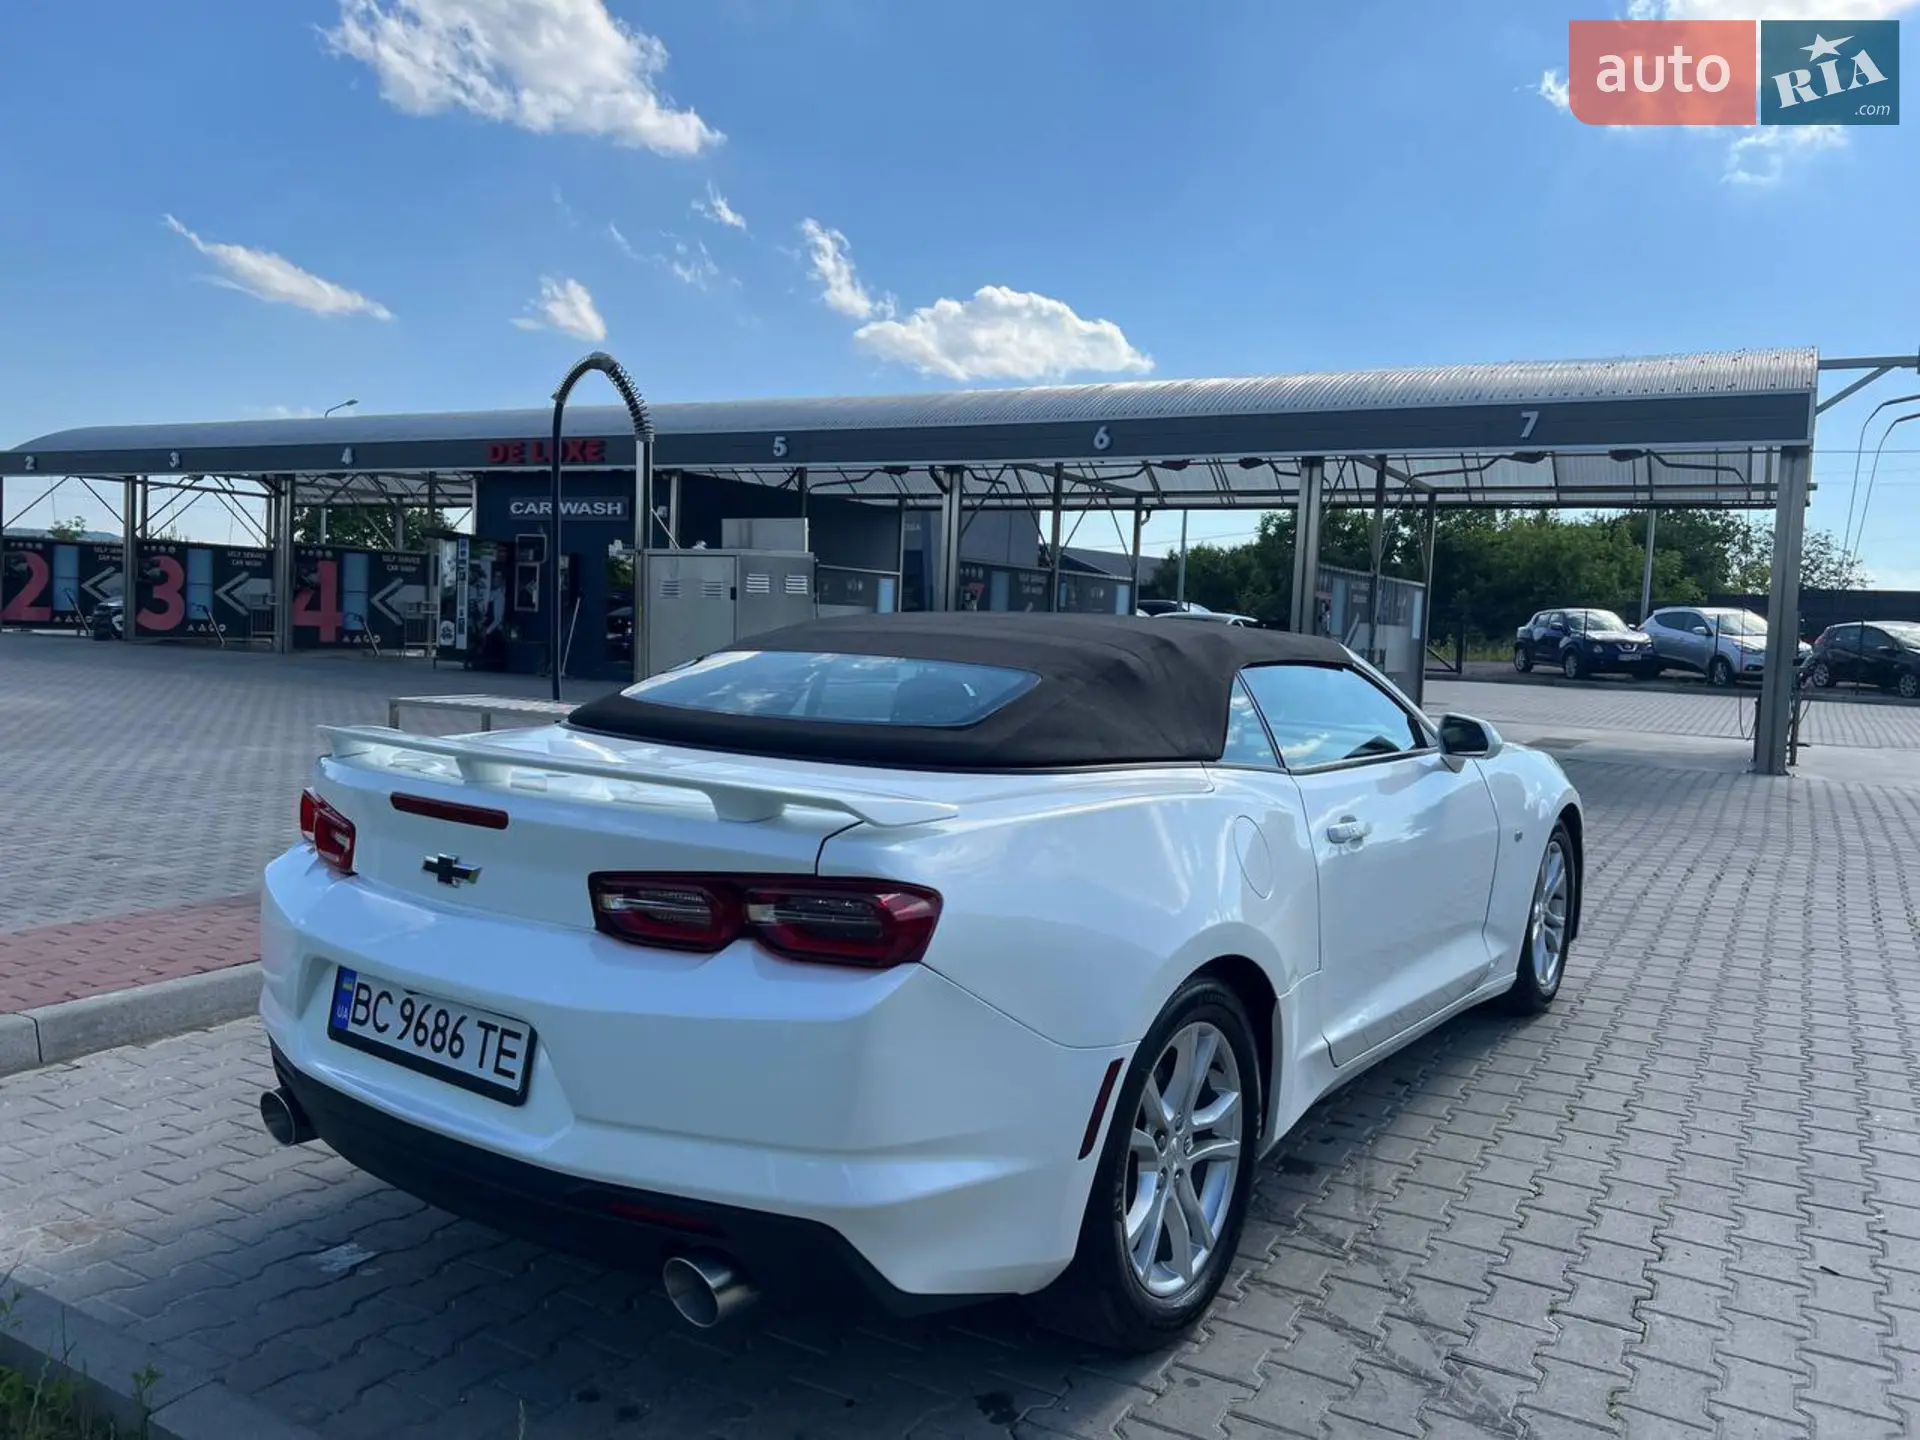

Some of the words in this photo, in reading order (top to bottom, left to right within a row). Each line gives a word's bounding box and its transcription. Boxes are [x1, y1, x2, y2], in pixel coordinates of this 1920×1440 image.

[1519, 411, 1539, 438] 7
[773, 436, 788, 457] 5
[1093, 426, 1111, 450] 6
[25, 455, 36, 471] 2
[168, 452, 181, 468] 3
[341, 448, 354, 465] 4
[487, 442, 523, 463] DE
[531, 440, 605, 462] LXE
[510, 502, 552, 515] CAR
[560, 501, 622, 516] WASH
[0, 550, 50, 621] 2
[137, 555, 185, 631] 3
[293, 560, 345, 643] 4
[336, 1005, 349, 1021] UA
[351, 982, 394, 1034] BC
[397, 997, 467, 1060] 9686
[477, 1019, 522, 1081] TE
